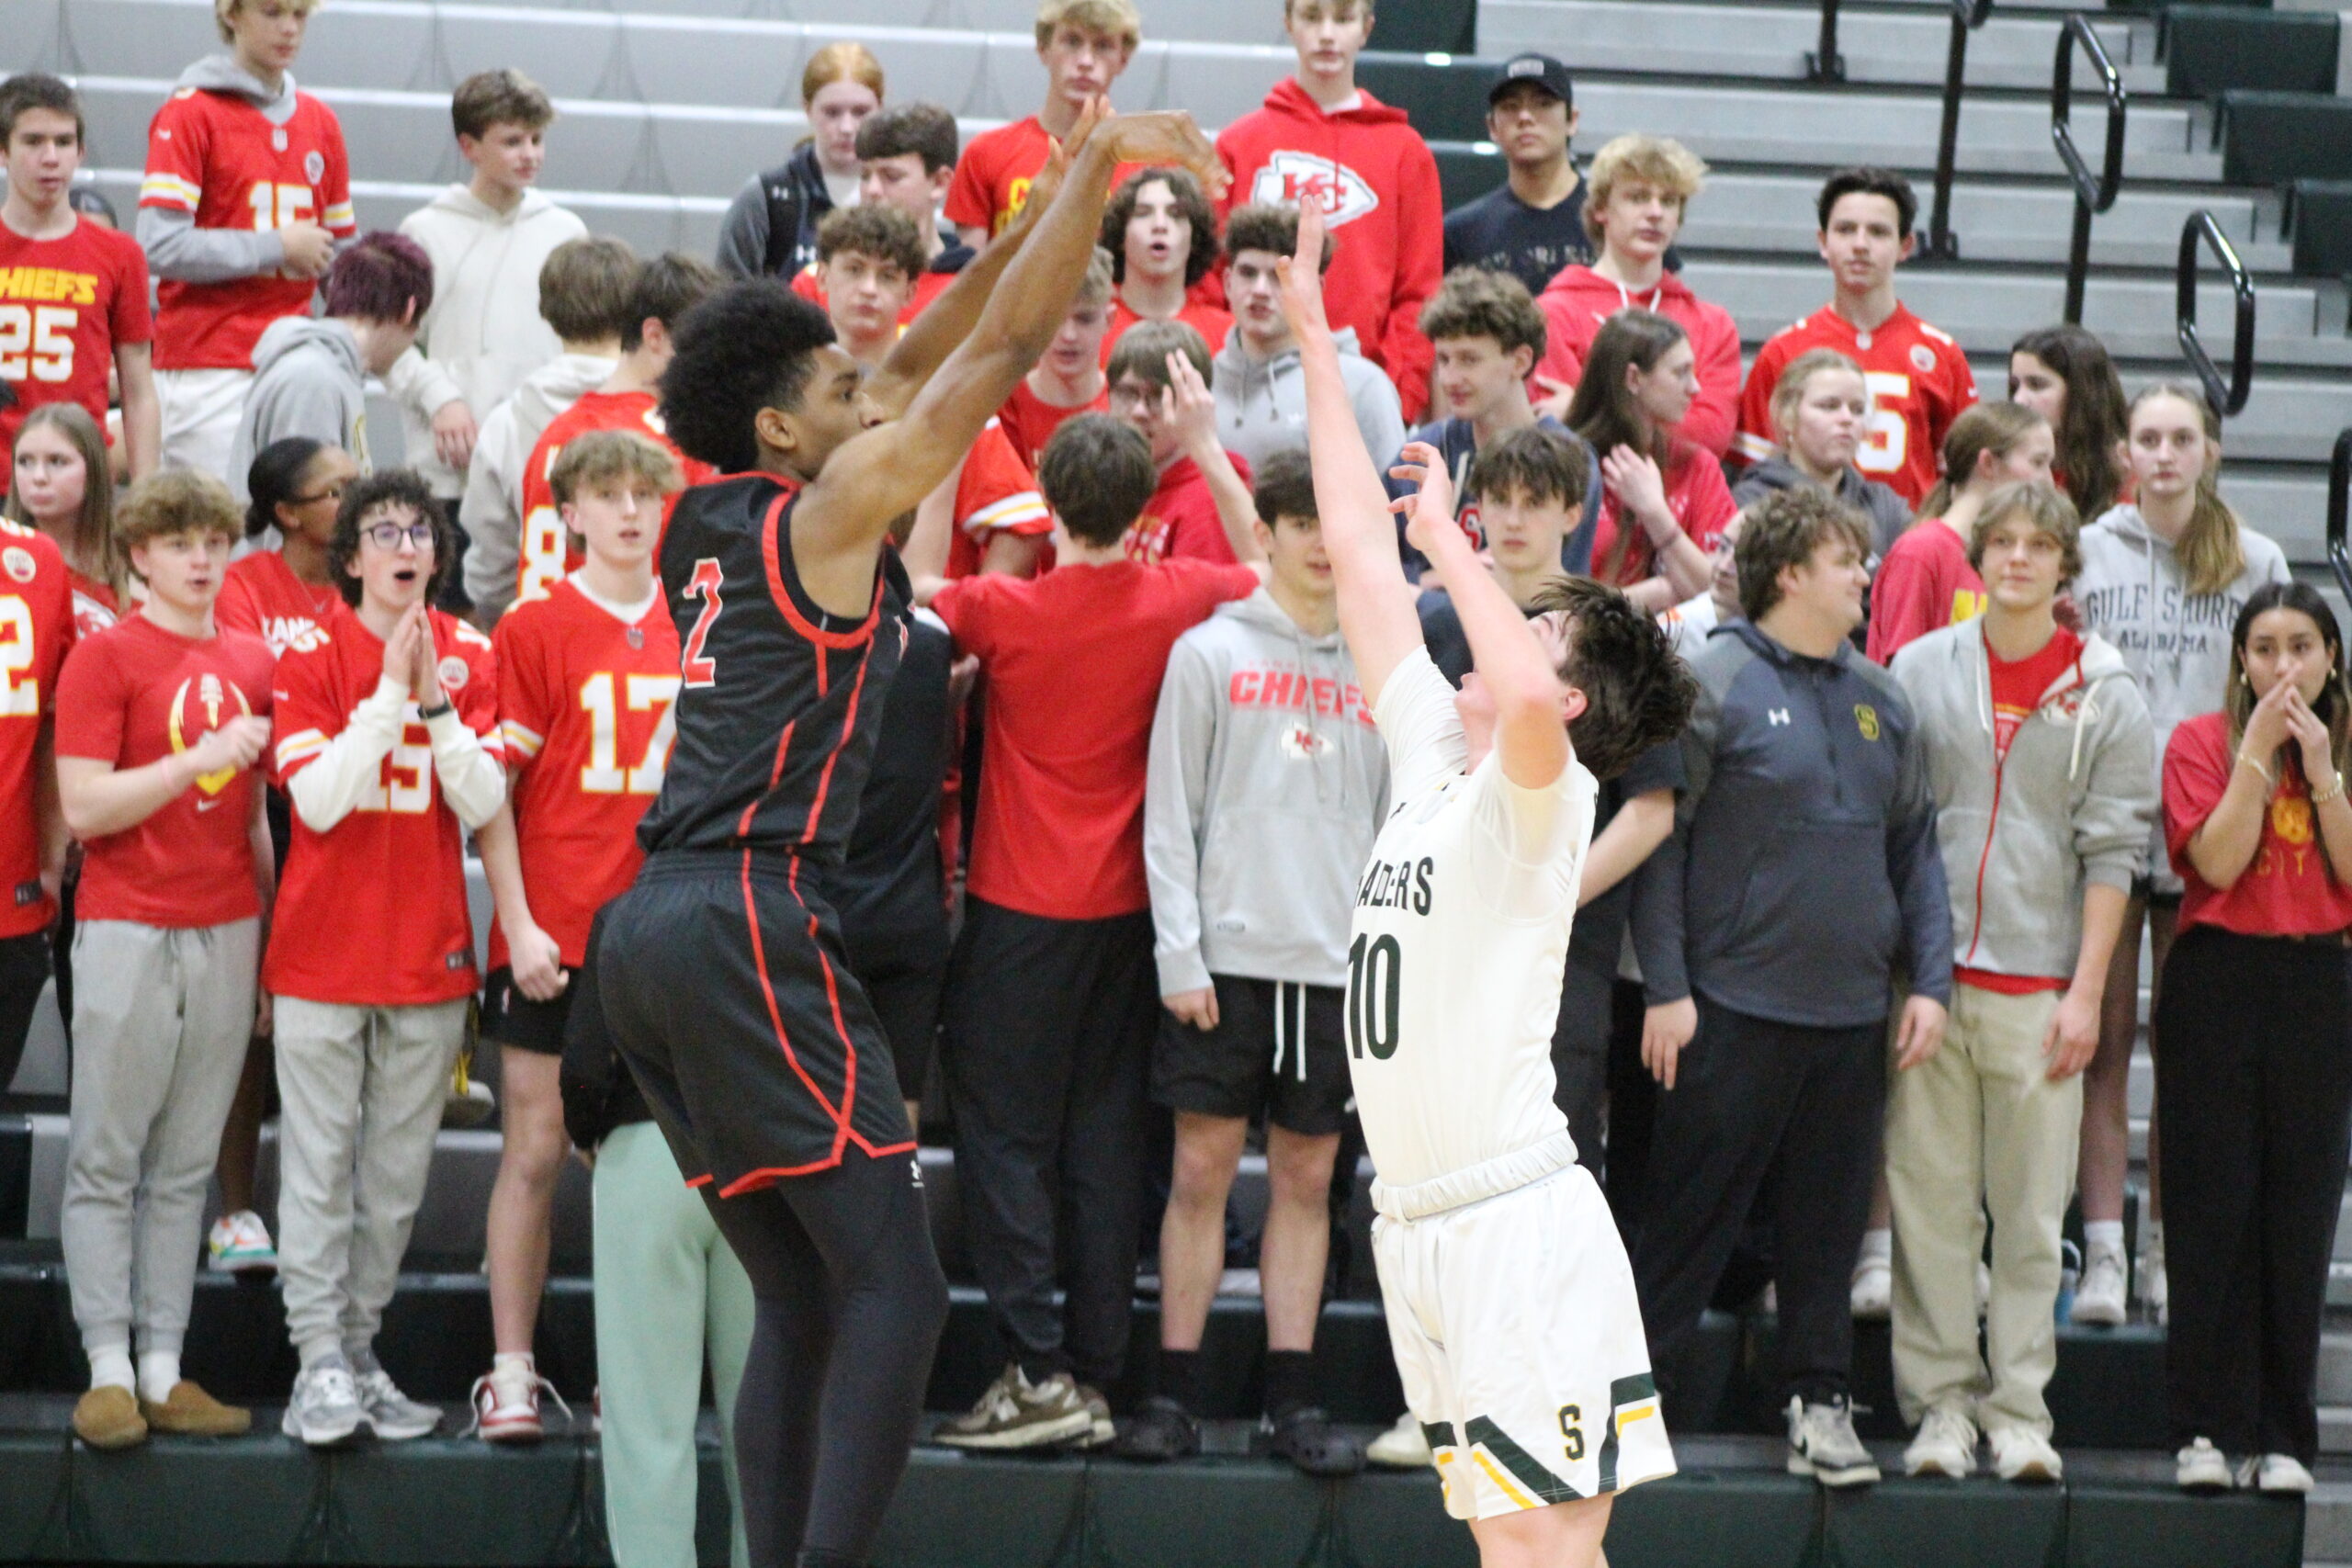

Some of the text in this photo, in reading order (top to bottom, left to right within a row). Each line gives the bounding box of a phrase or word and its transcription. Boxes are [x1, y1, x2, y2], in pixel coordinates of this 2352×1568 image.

[0, 266, 98, 305] HIEFS
[0, 304, 78, 381] 25
[684, 557, 724, 689] 2
[2086, 582, 2148, 627] GULF
[580, 671, 683, 795] 17
[1353, 856, 1434, 917] ADRS
[1348, 931, 1401, 1061] 10
[1557, 1404, 1585, 1462] S
